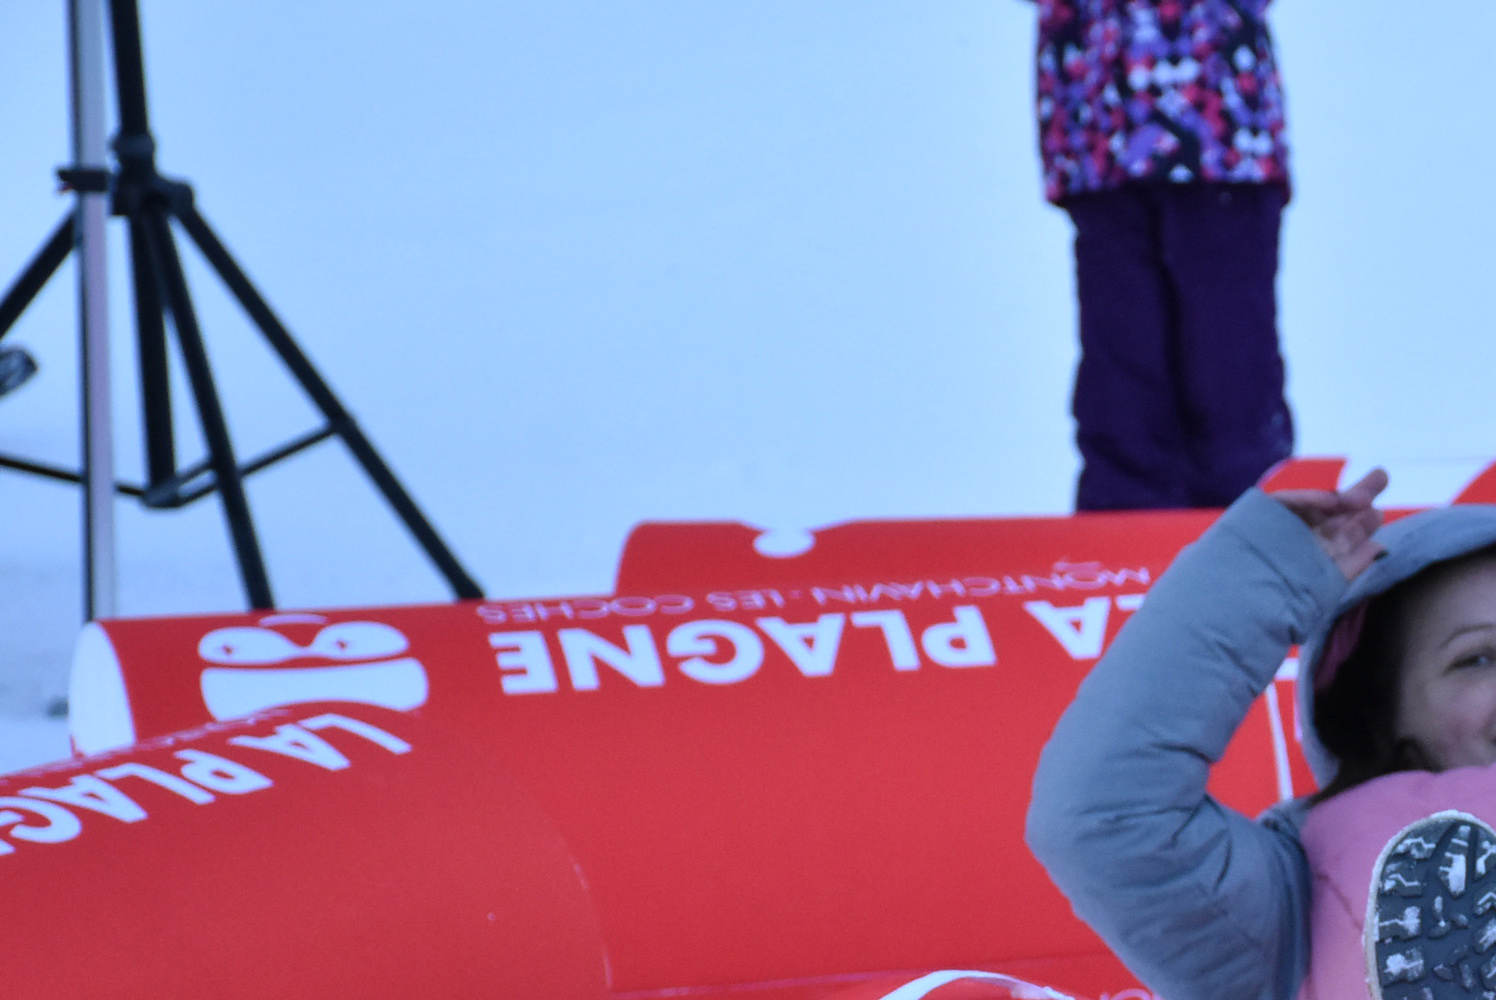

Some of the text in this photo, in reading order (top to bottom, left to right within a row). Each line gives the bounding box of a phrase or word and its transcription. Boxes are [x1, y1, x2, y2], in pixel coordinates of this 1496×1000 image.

[476, 594, 695, 624] COCHES
[487, 604, 998, 695] PLAGNE
[228, 712, 413, 771] LA
[0, 748, 274, 856] PLAG
